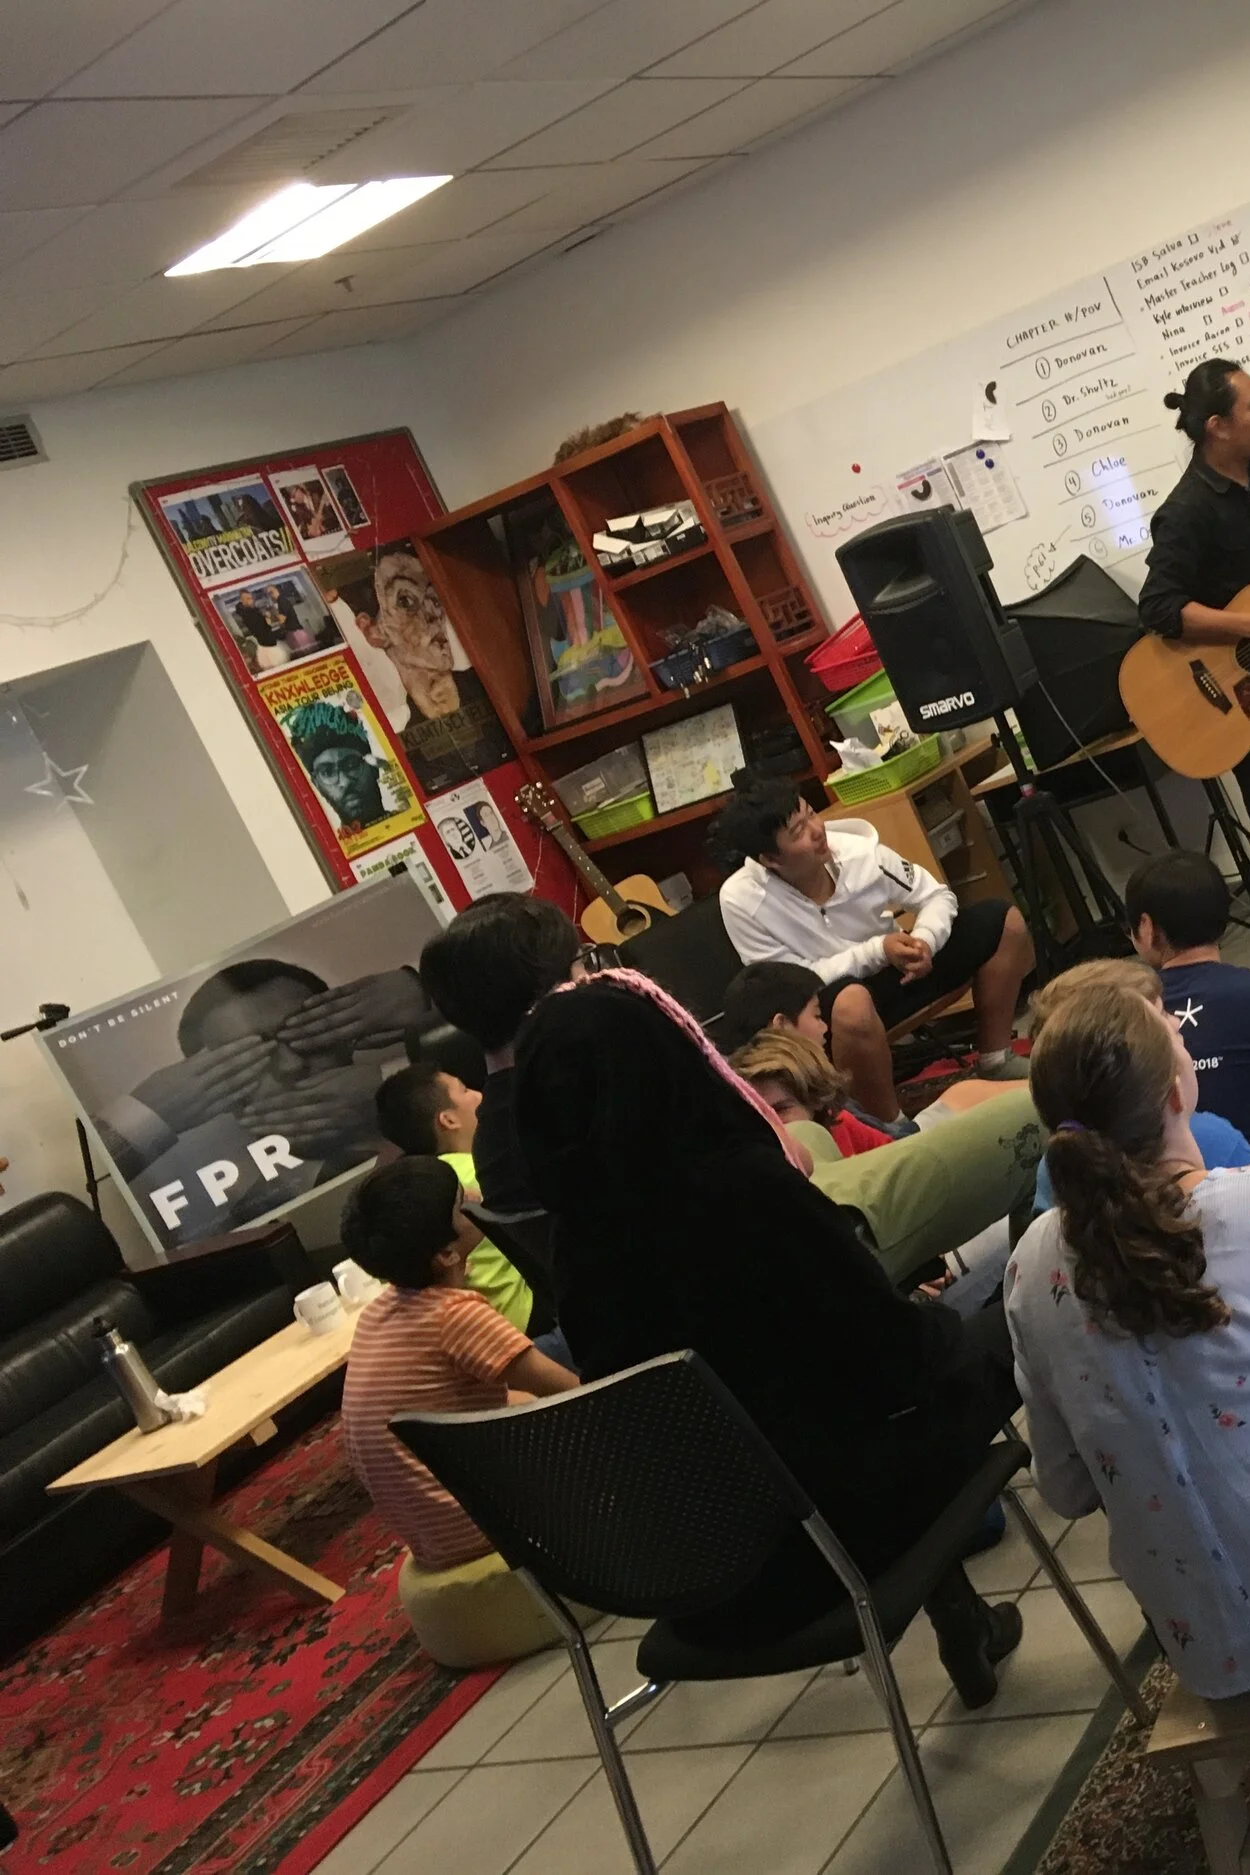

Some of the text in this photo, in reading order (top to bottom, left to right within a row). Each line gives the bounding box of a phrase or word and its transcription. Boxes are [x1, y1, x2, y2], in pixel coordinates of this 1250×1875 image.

[1137, 266, 1169, 290] Email
[1171, 252, 1204, 272] Kosovo
[1144, 261, 1237, 310] Master Teacher Log
[1153, 310, 1172, 325] Kyle
[1175, 296, 1213, 316] interview
[1006, 319, 1060, 349] CHAPTER
[1162, 326, 1185, 341] Nina
[1169, 340, 1200, 357] Invoice
[1204, 326, 1230, 342] Aaron
[1055, 344, 1108, 369] Donovan
[1080, 378, 1118, 398] Shultz
[1073, 417, 1129, 442] Donovan
[1092, 456, 1127, 478] Chloe
[842, 494, 875, 512] Question
[1102, 488, 1158, 510] Donovan
[265, 666, 349, 706] KNXWLEDGE
[295, 692, 320, 706] TOUR
[322, 680, 354, 698] BEIJING
[58, 991, 178, 1048] DON'T BE SILENT
[149, 1134, 304, 1230] FPR
